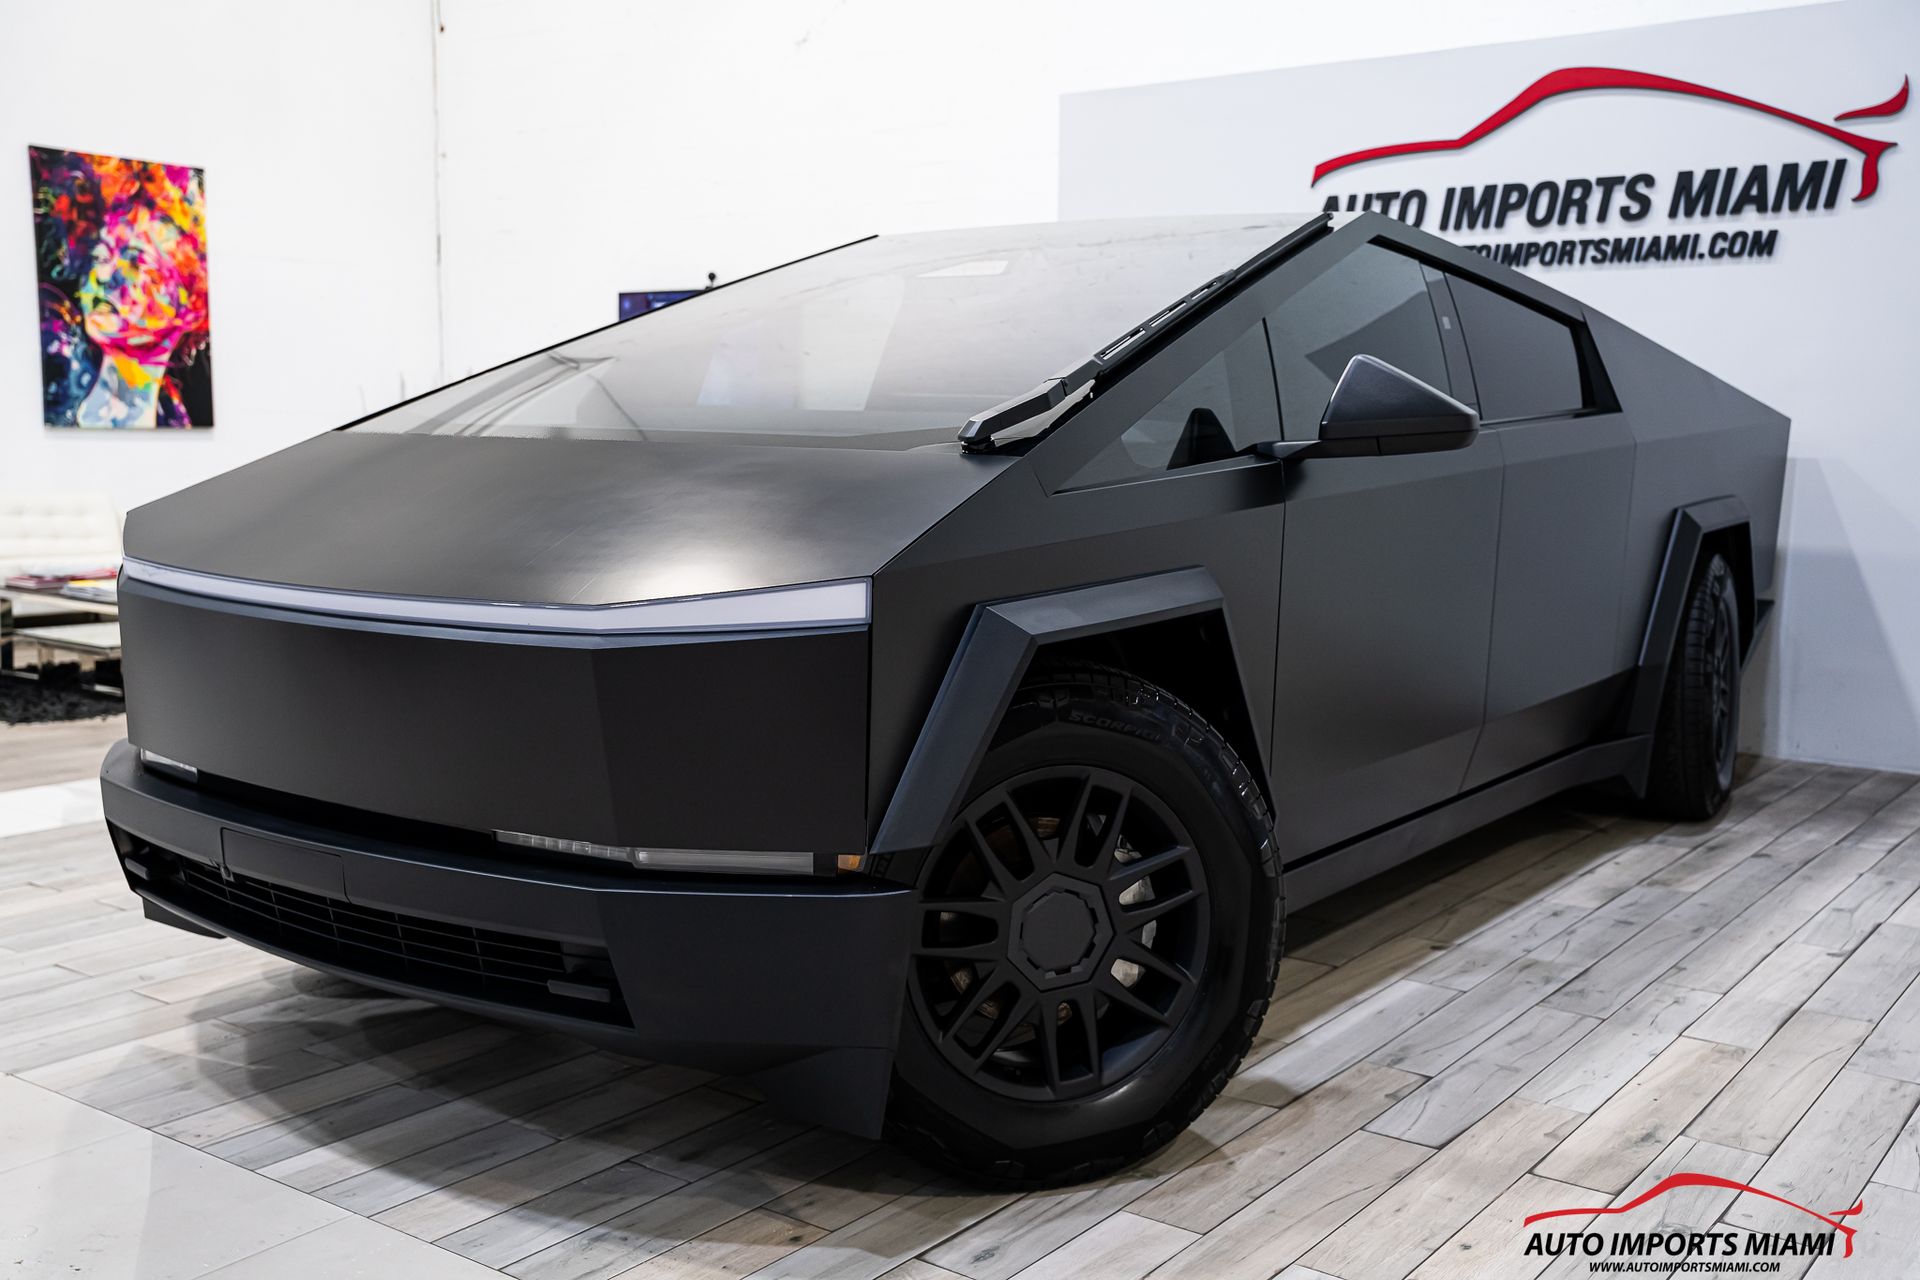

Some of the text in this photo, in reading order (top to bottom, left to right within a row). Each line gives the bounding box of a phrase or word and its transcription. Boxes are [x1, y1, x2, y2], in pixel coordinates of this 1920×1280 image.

[1440, 173, 1655, 231] IMPORTS
[1669, 158, 1848, 218] MIAMI
[1464, 229, 1778, 267] OIMPORTSMIAMI.COM
